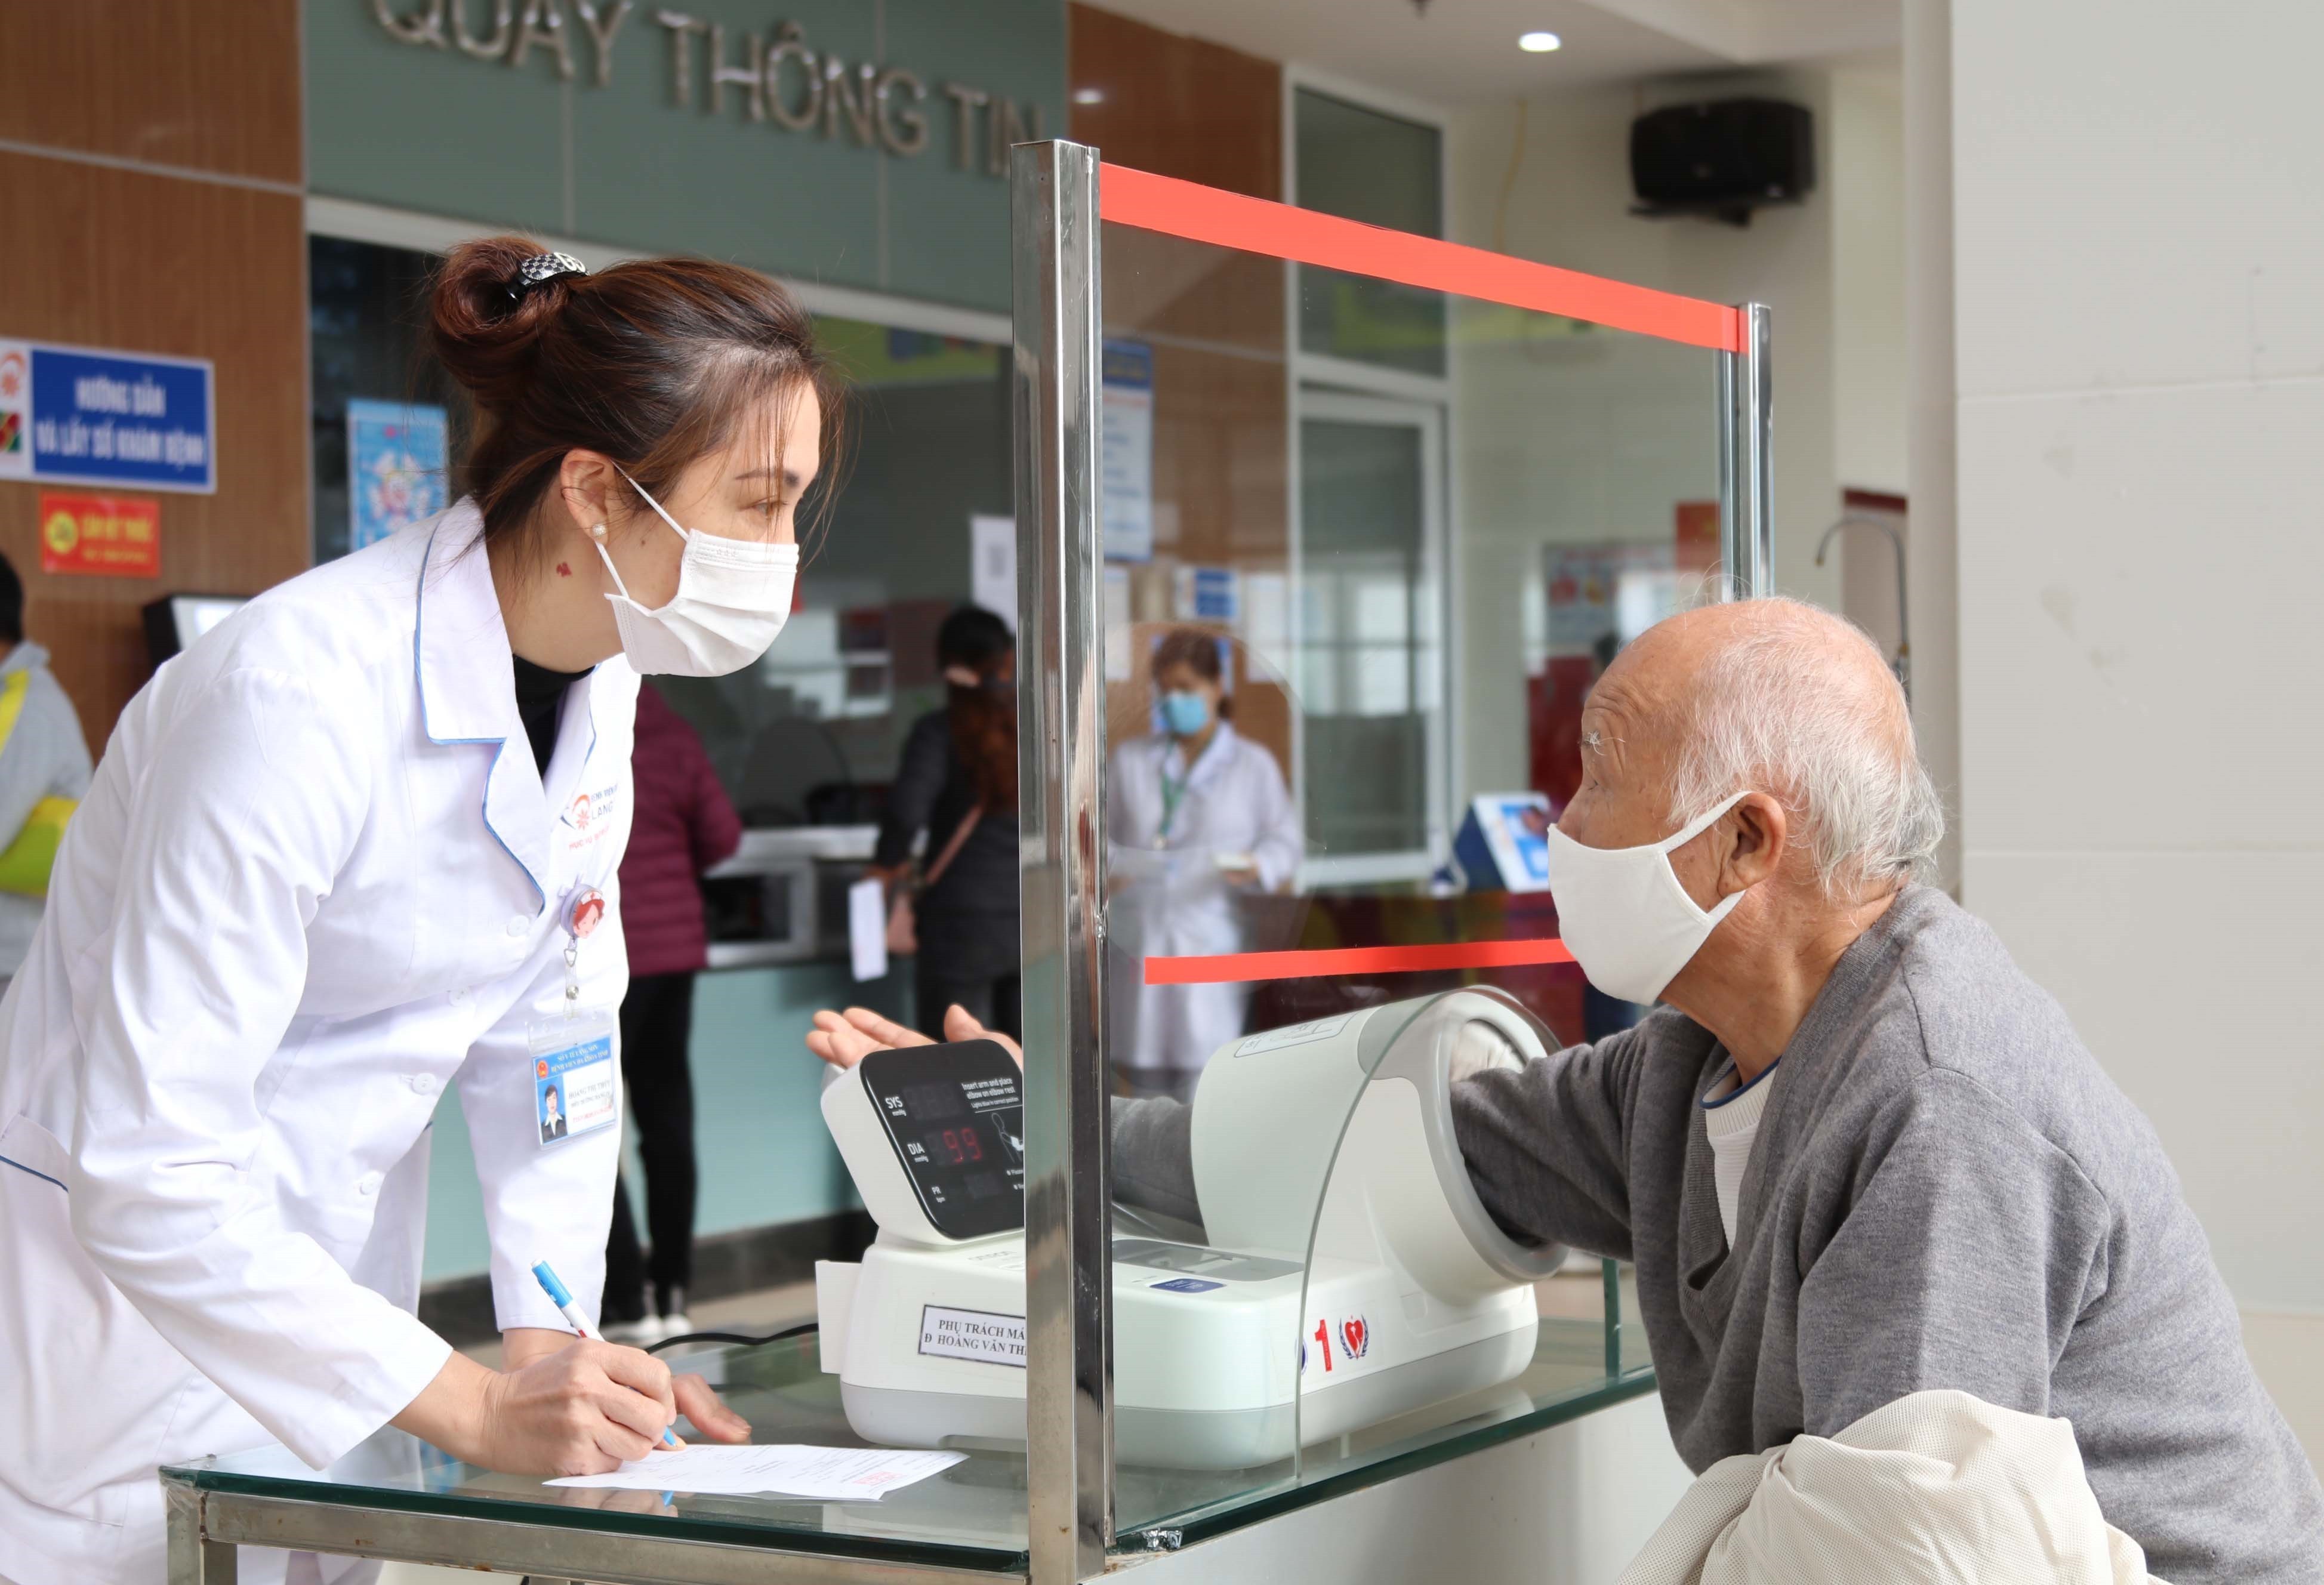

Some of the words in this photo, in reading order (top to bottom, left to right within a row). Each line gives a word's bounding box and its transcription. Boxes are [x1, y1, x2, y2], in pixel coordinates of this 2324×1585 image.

[655, 11, 928, 155] THÔNG
[989, 1078, 998, 1087] and
[998, 1078, 1012, 1087] place
[885, 1096, 903, 1109] SYS
[907, 1142, 924, 1155] DIA
[942, 1127, 982, 1162] 99
[932, 1186, 941, 1195] PR
[939, 1319, 961, 1334] PHỤ
[965, 1322, 1004, 1337] TRÁCH
[938, 1334, 979, 1349] HOÀNG
[1315, 1319, 1332, 1372] 1
